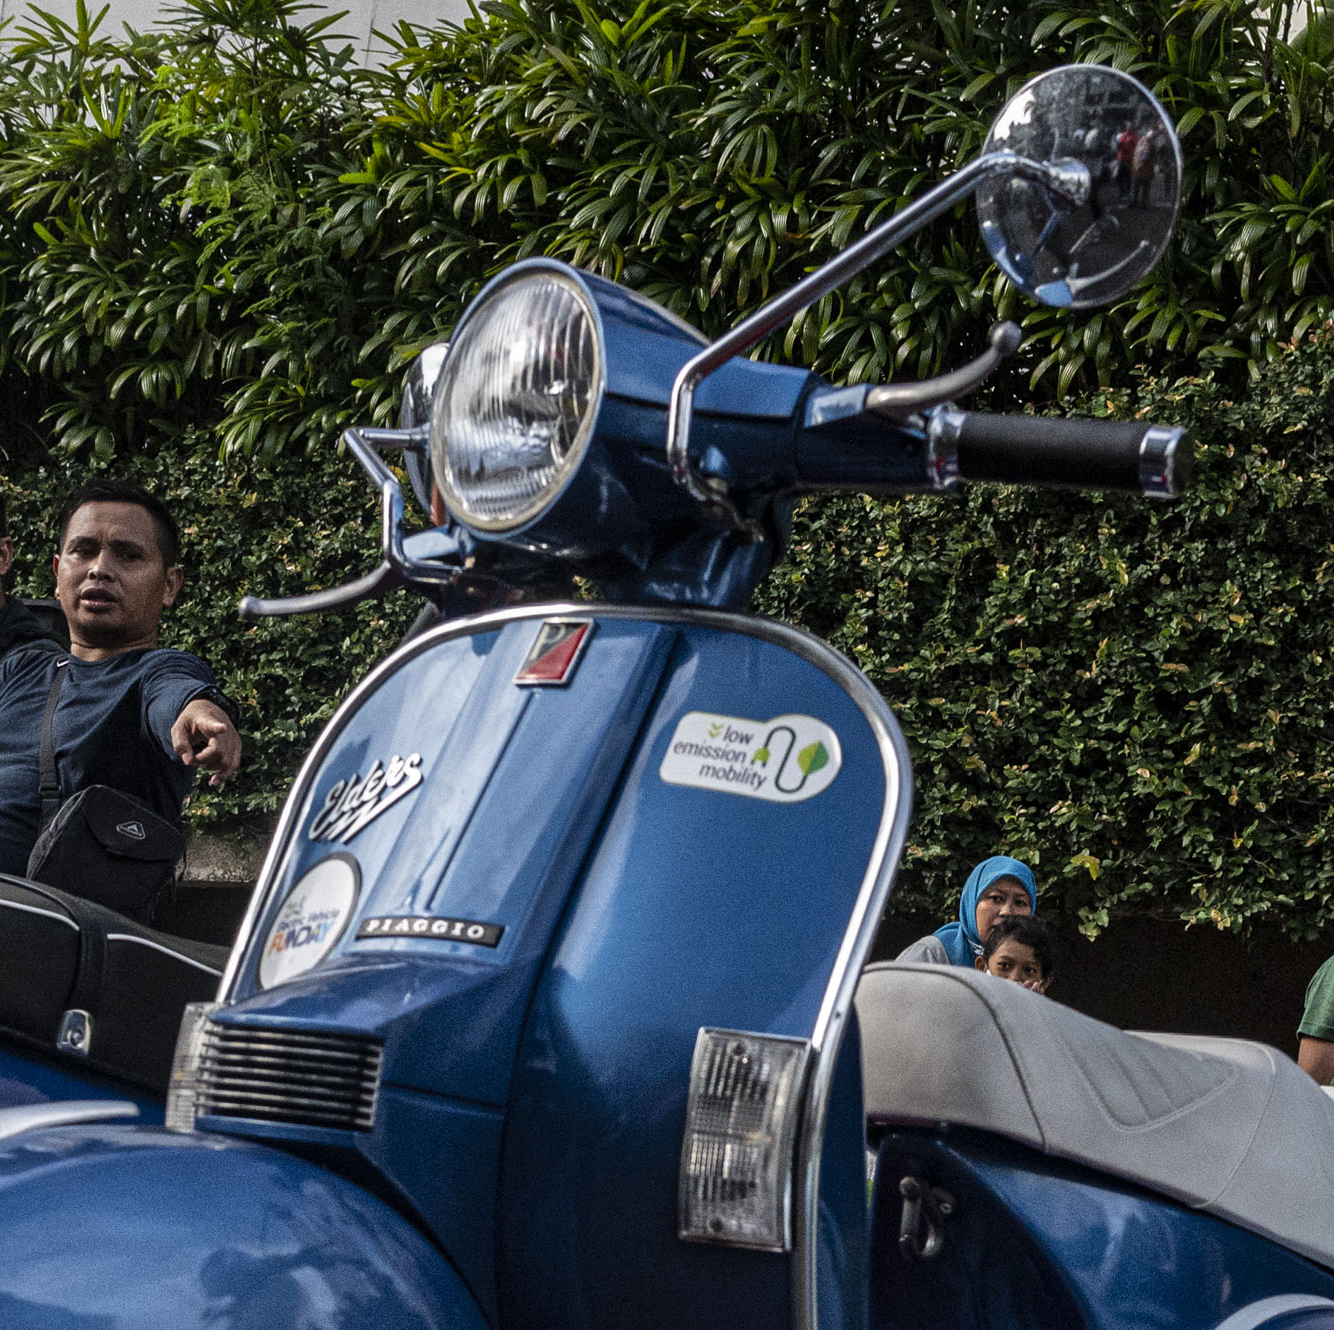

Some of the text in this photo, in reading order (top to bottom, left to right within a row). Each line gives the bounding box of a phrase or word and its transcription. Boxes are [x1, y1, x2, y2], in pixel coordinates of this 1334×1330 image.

[723, 725, 754, 746] low
[673, 739, 747, 764] emission
[699, 762, 767, 791] mobility
[308, 753, 425, 846] Elders
[366, 918, 485, 940] PIAGGIO
